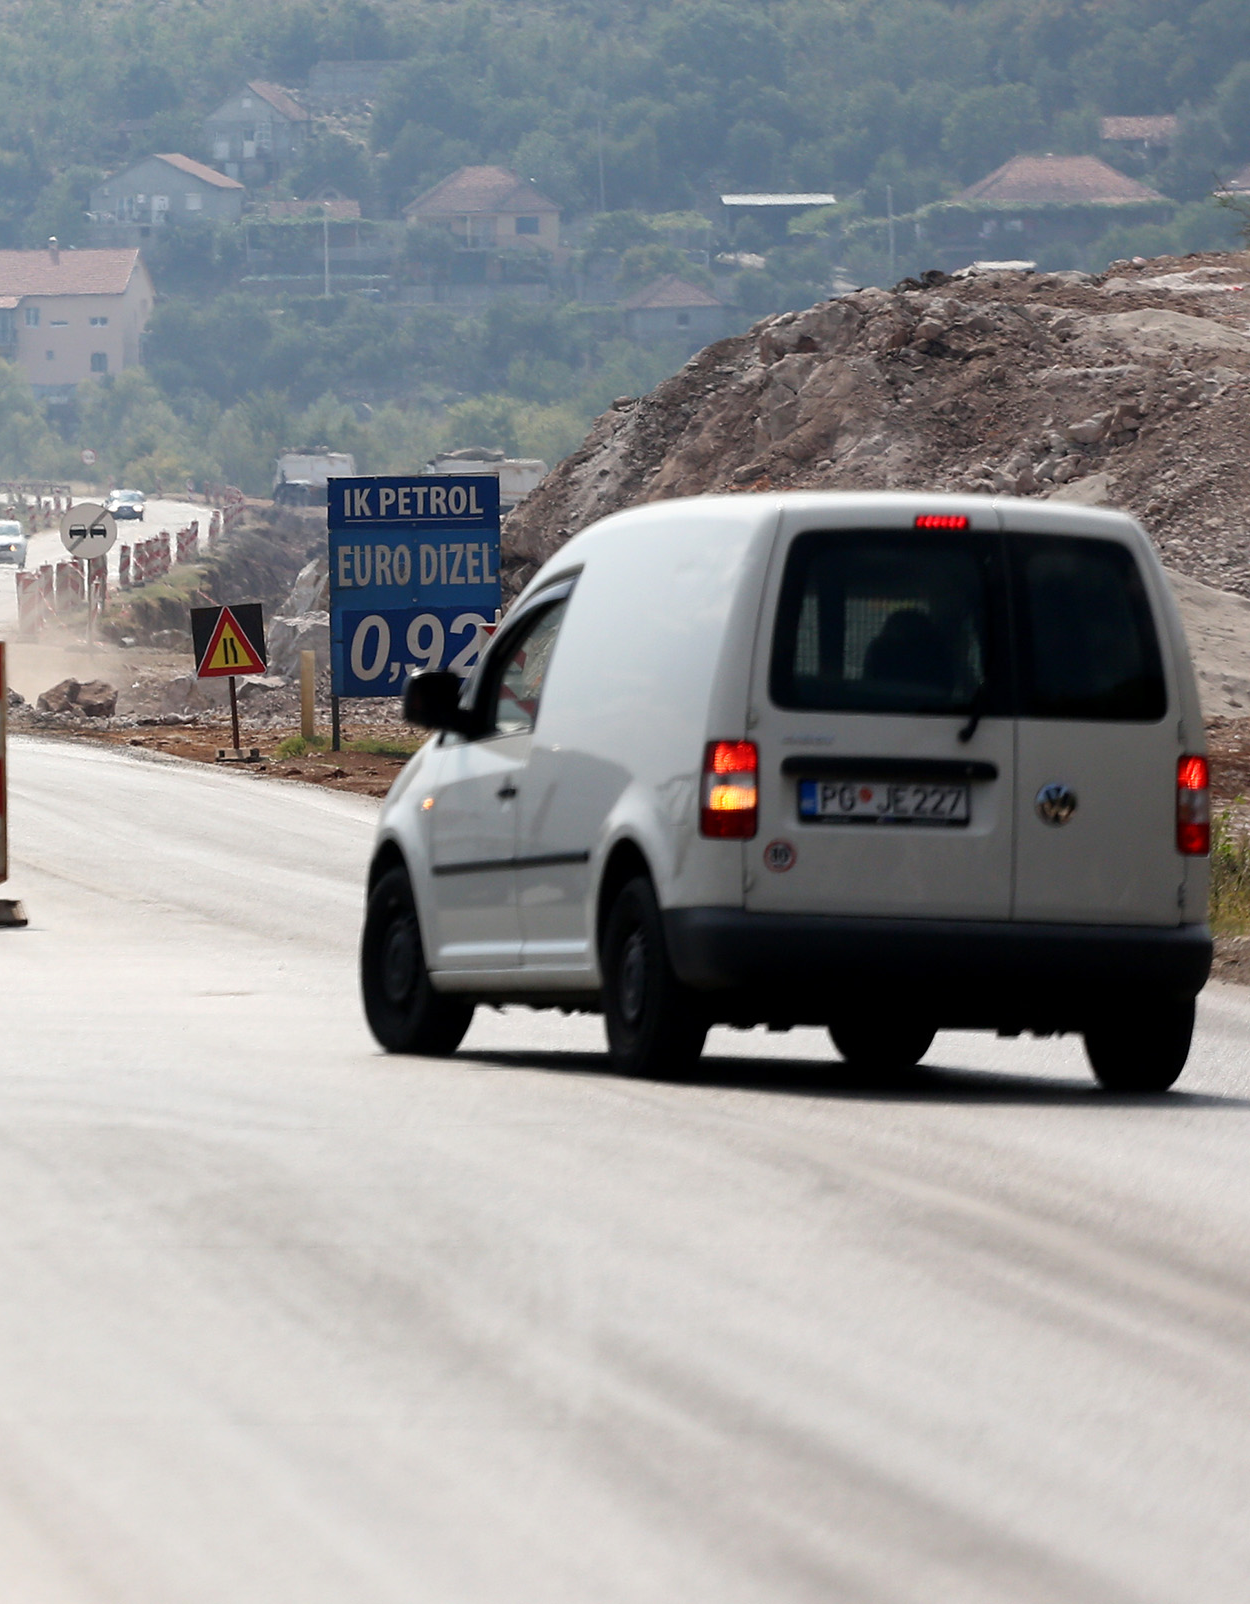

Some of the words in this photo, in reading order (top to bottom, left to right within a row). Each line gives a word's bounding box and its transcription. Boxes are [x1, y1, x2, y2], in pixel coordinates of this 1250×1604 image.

[344, 488, 372, 516] IK
[379, 486, 484, 515] PETROL
[338, 544, 411, 587] EURO
[419, 542, 497, 585] DIZEL
[821, 785, 856, 812] PG
[876, 786, 964, 816] JE227
